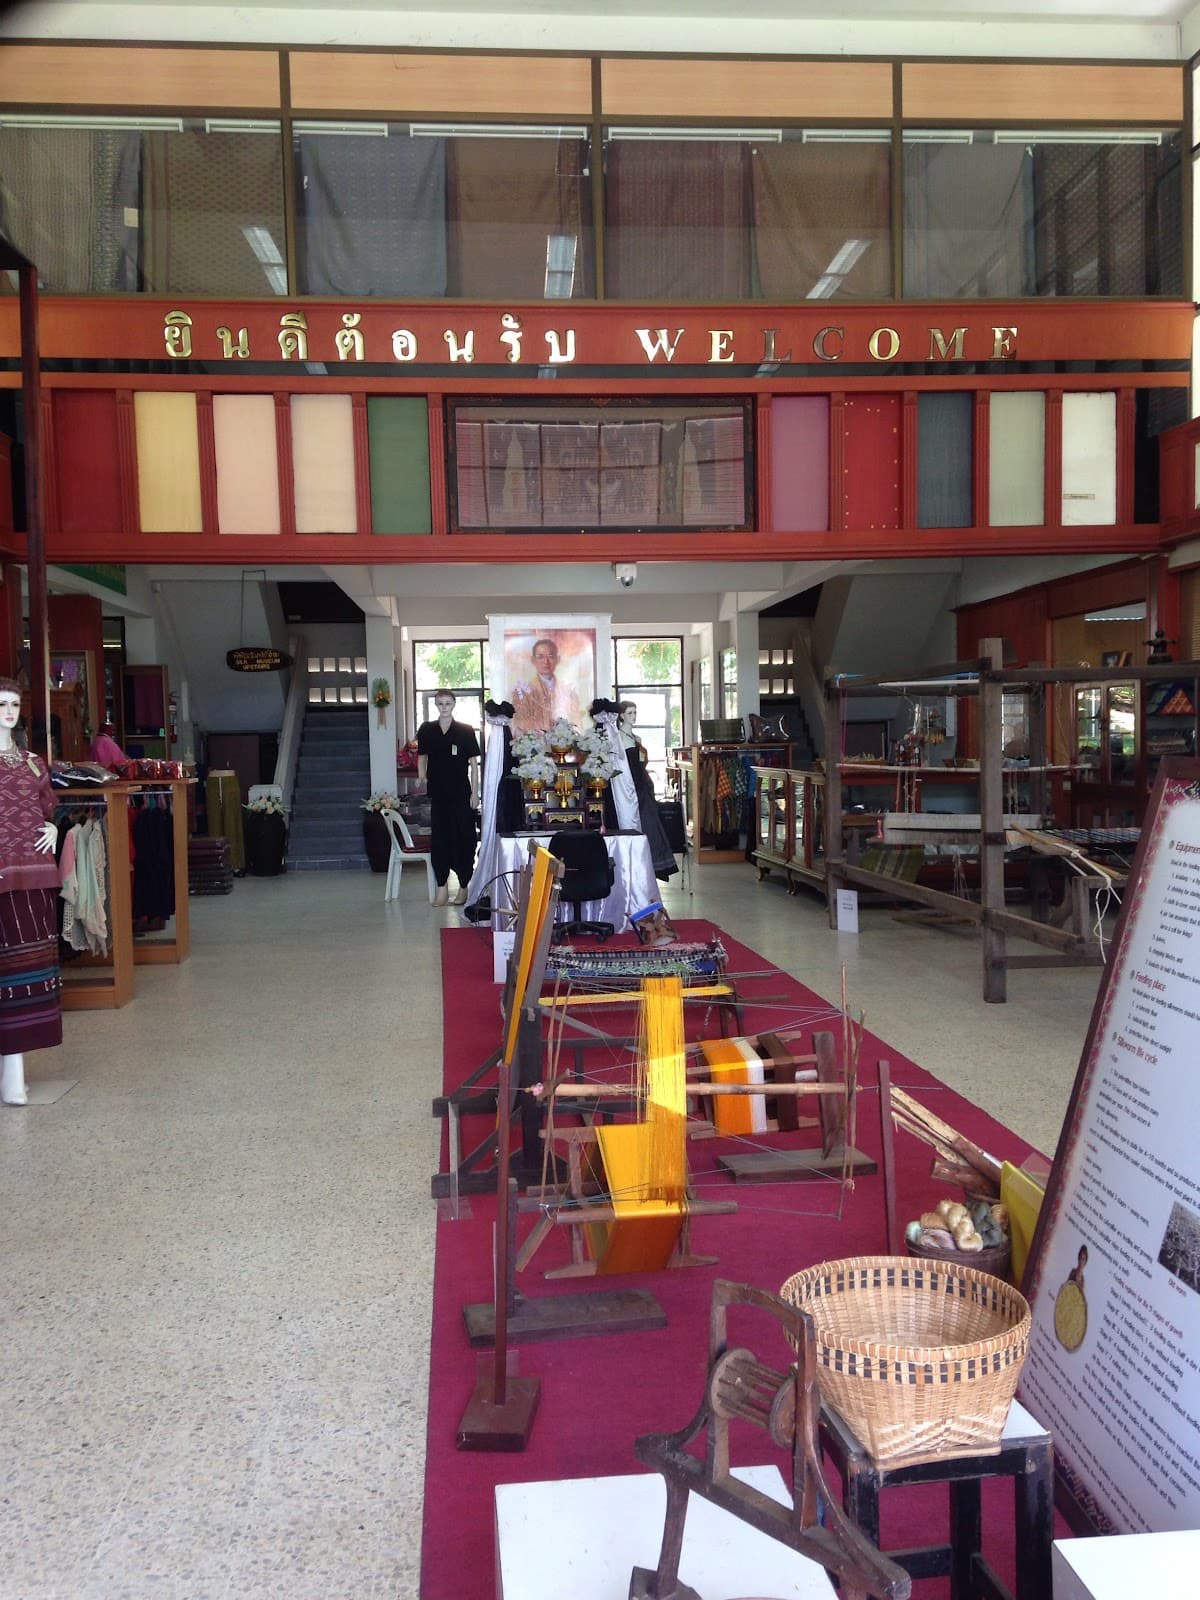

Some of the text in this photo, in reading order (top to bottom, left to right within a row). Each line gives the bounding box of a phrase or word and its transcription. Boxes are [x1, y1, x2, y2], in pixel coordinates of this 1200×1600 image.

[162, 310, 577, 364] ยินดีต้อนรับ
[634, 326, 1019, 364] WELCOME
[1134, 971, 1166, 991] Feeding place
[1116, 1035, 1157, 1065] Silkworm life cycle
